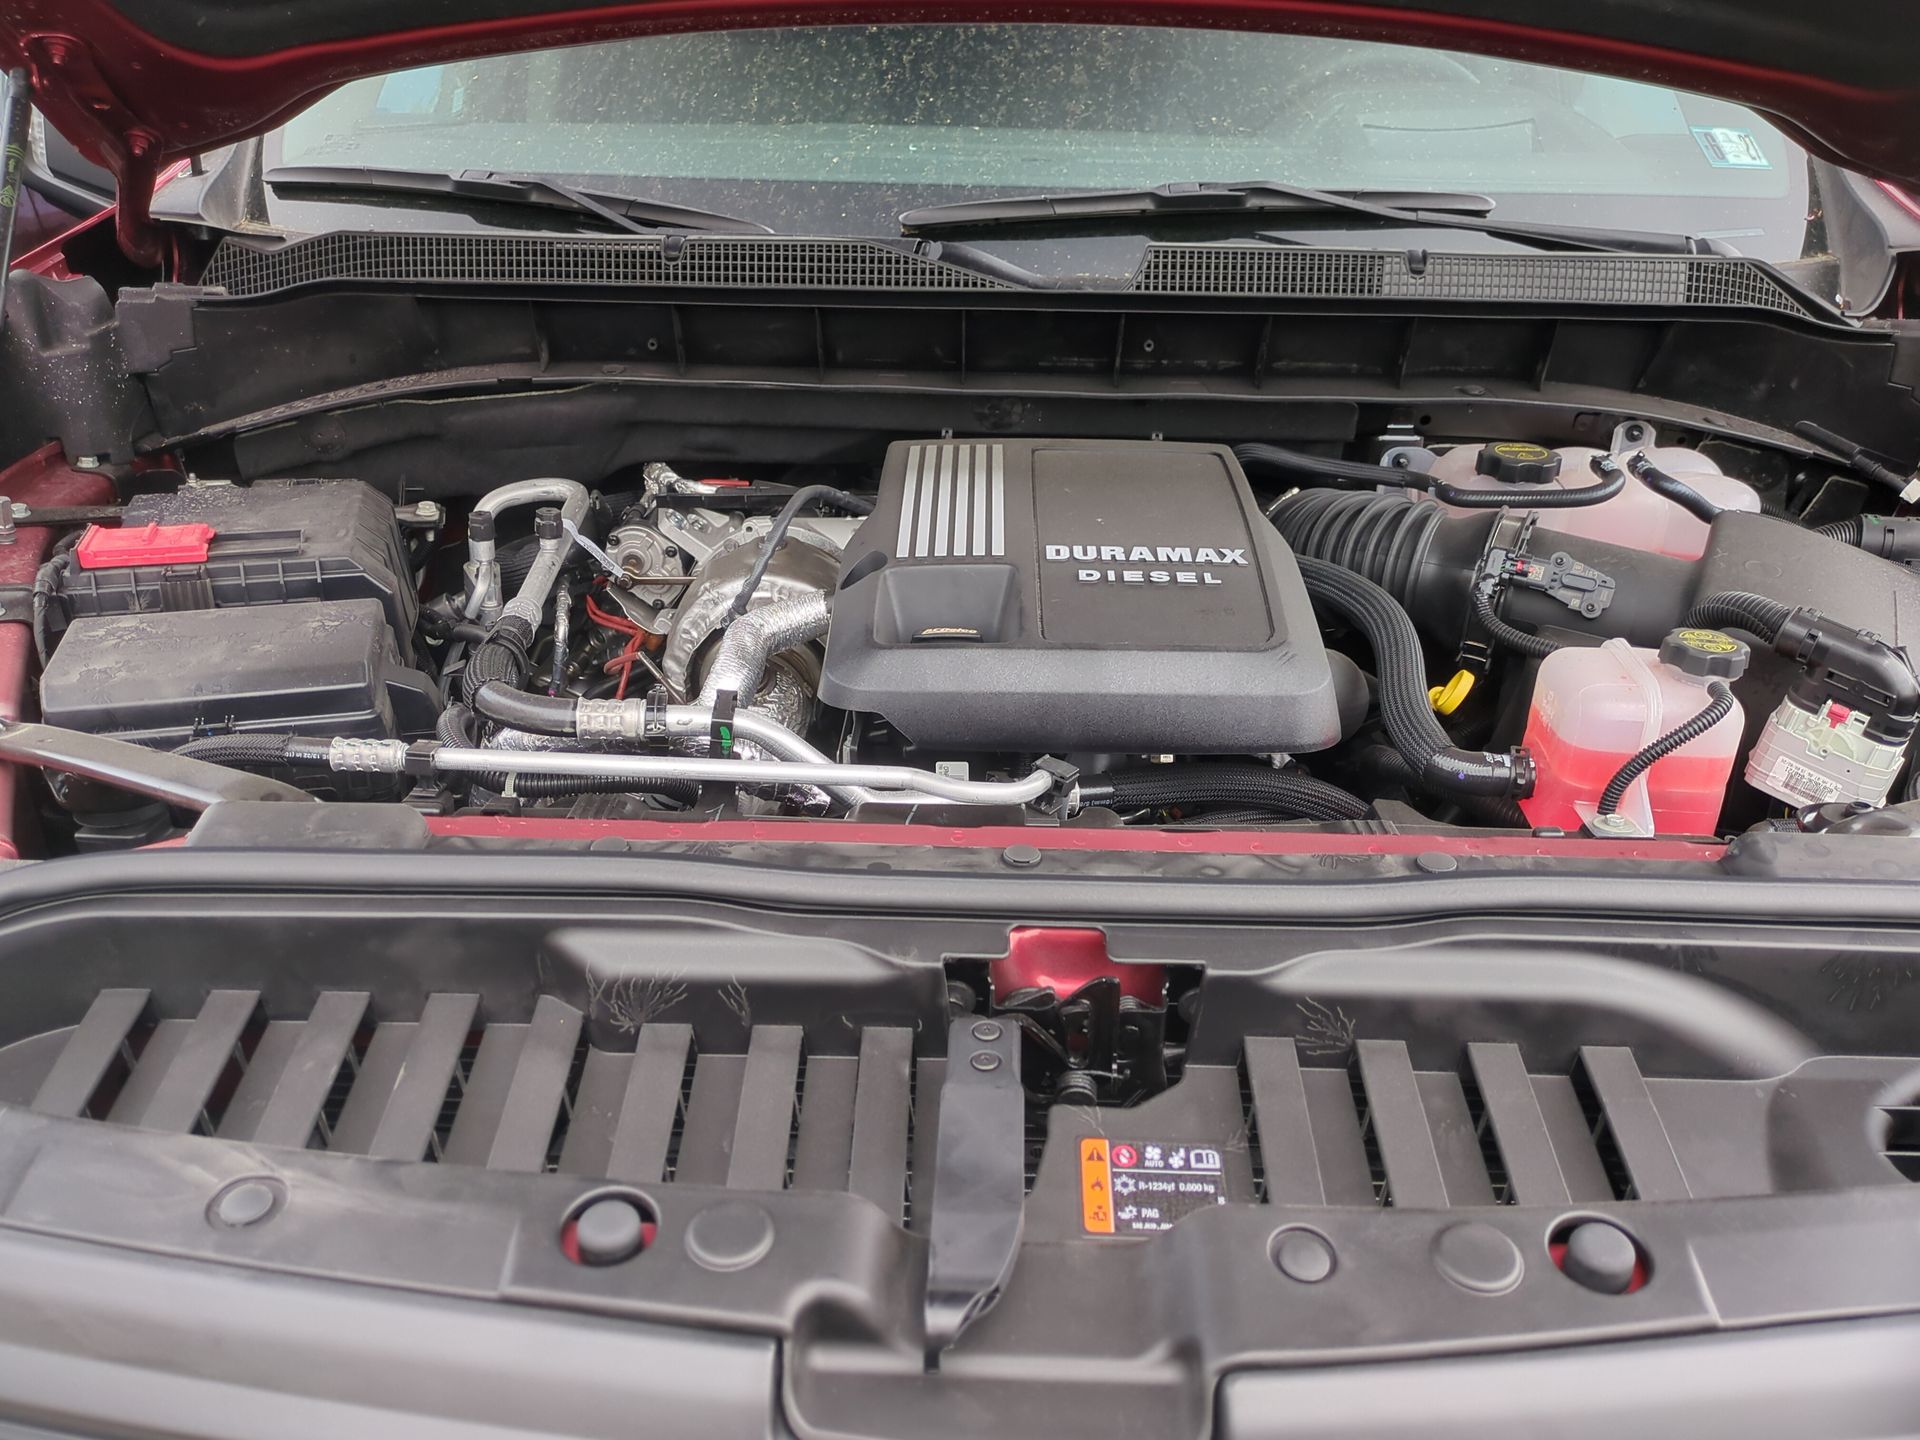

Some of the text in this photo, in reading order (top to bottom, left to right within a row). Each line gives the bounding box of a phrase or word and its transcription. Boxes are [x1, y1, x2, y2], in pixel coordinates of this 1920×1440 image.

[1045, 544, 1249, 566] DURAMAX
[1078, 569, 1222, 585] DIESEL
[1144, 1160, 1164, 1168] AUTO
[1203, 1183, 1215, 1194] kg
[1141, 1207, 1160, 1219] PAG
